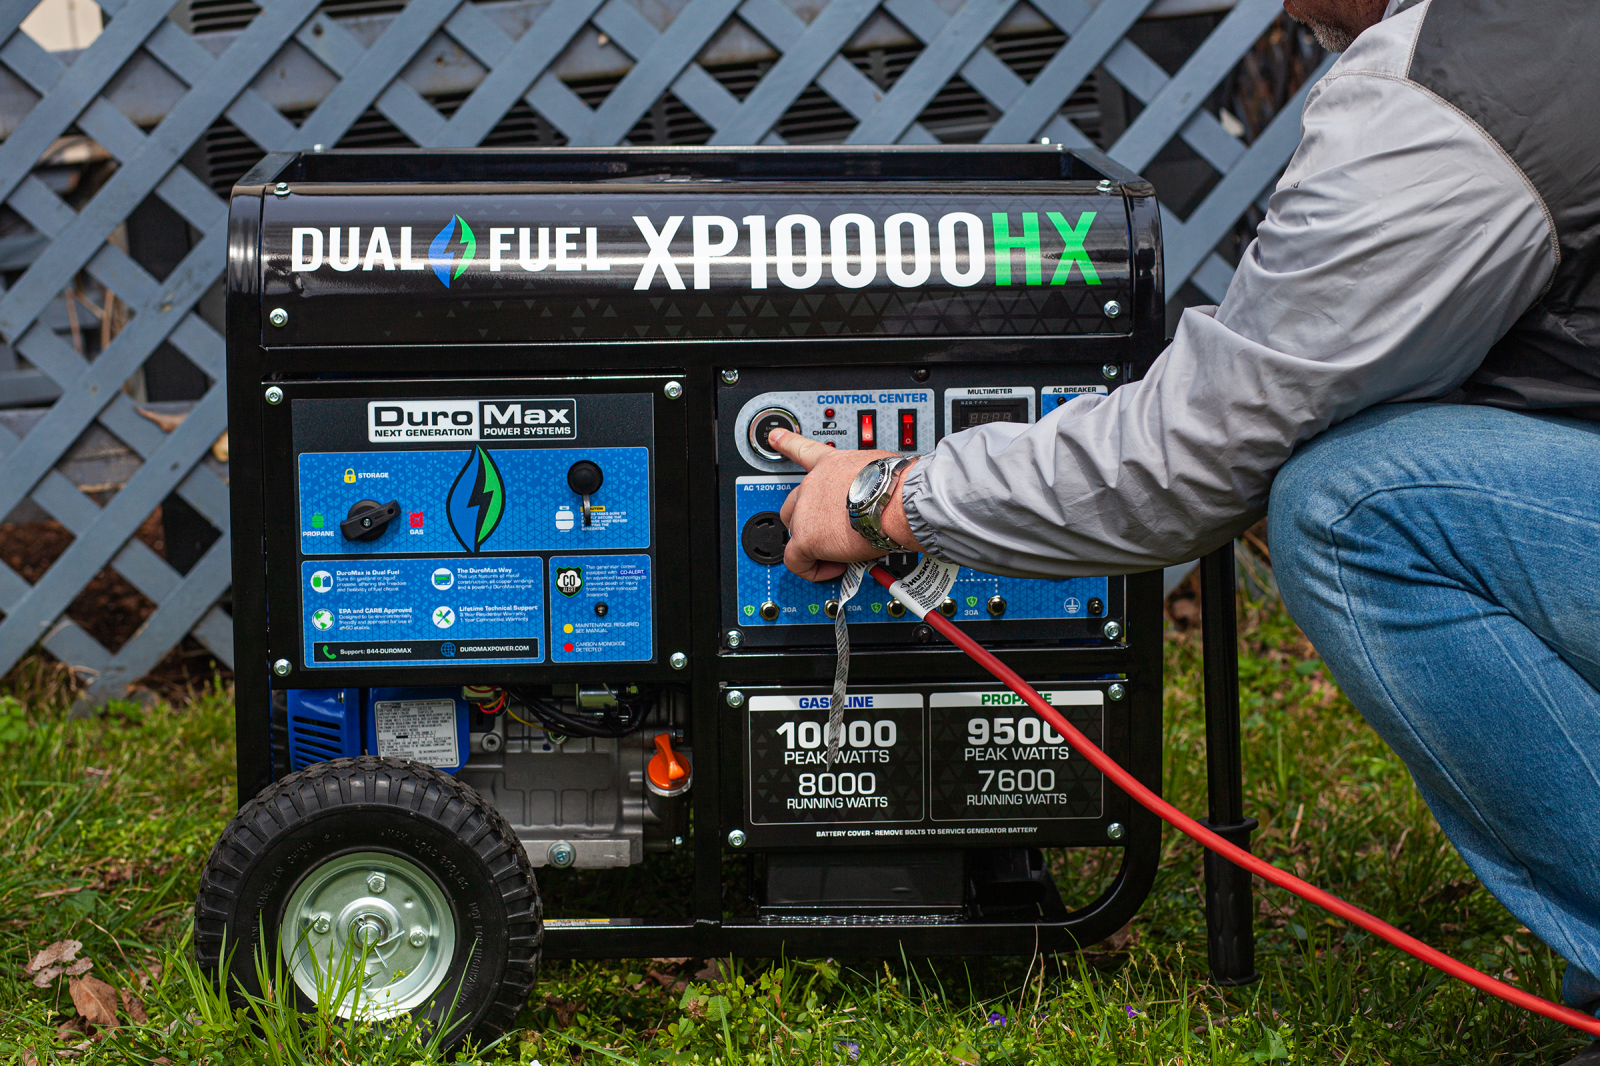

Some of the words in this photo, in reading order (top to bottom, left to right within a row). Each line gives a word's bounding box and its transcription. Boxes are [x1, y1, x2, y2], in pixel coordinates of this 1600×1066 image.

[291, 227, 424, 272] DUAL
[490, 227, 610, 272] FUEL
[633, 211, 1101, 290] XP10000HX
[817, 394, 876, 404] CONTROL
[879, 393, 928, 403] CENTER
[375, 429, 403, 437] NEXT
[406, 428, 473, 437] GENERATION
[484, 427, 521, 436] POWER
[524, 426, 571, 435] SYSTEMS
[563, 575, 576, 586] CO
[799, 696, 873, 709] GASLINE
[784, 751, 828, 765] PEAK
[834, 750, 890, 763] WATTS
[964, 748, 1008, 761] PEAK
[1012, 746, 1069, 760] WATTS
[799, 772, 876, 796] 8000
[978, 769, 1055, 792] 7600
[787, 798, 843, 809] RUNNING
[846, 797, 888, 808] WATTS
[967, 794, 1023, 806] RUNNING
[1025, 793, 1067, 805] WATTS
